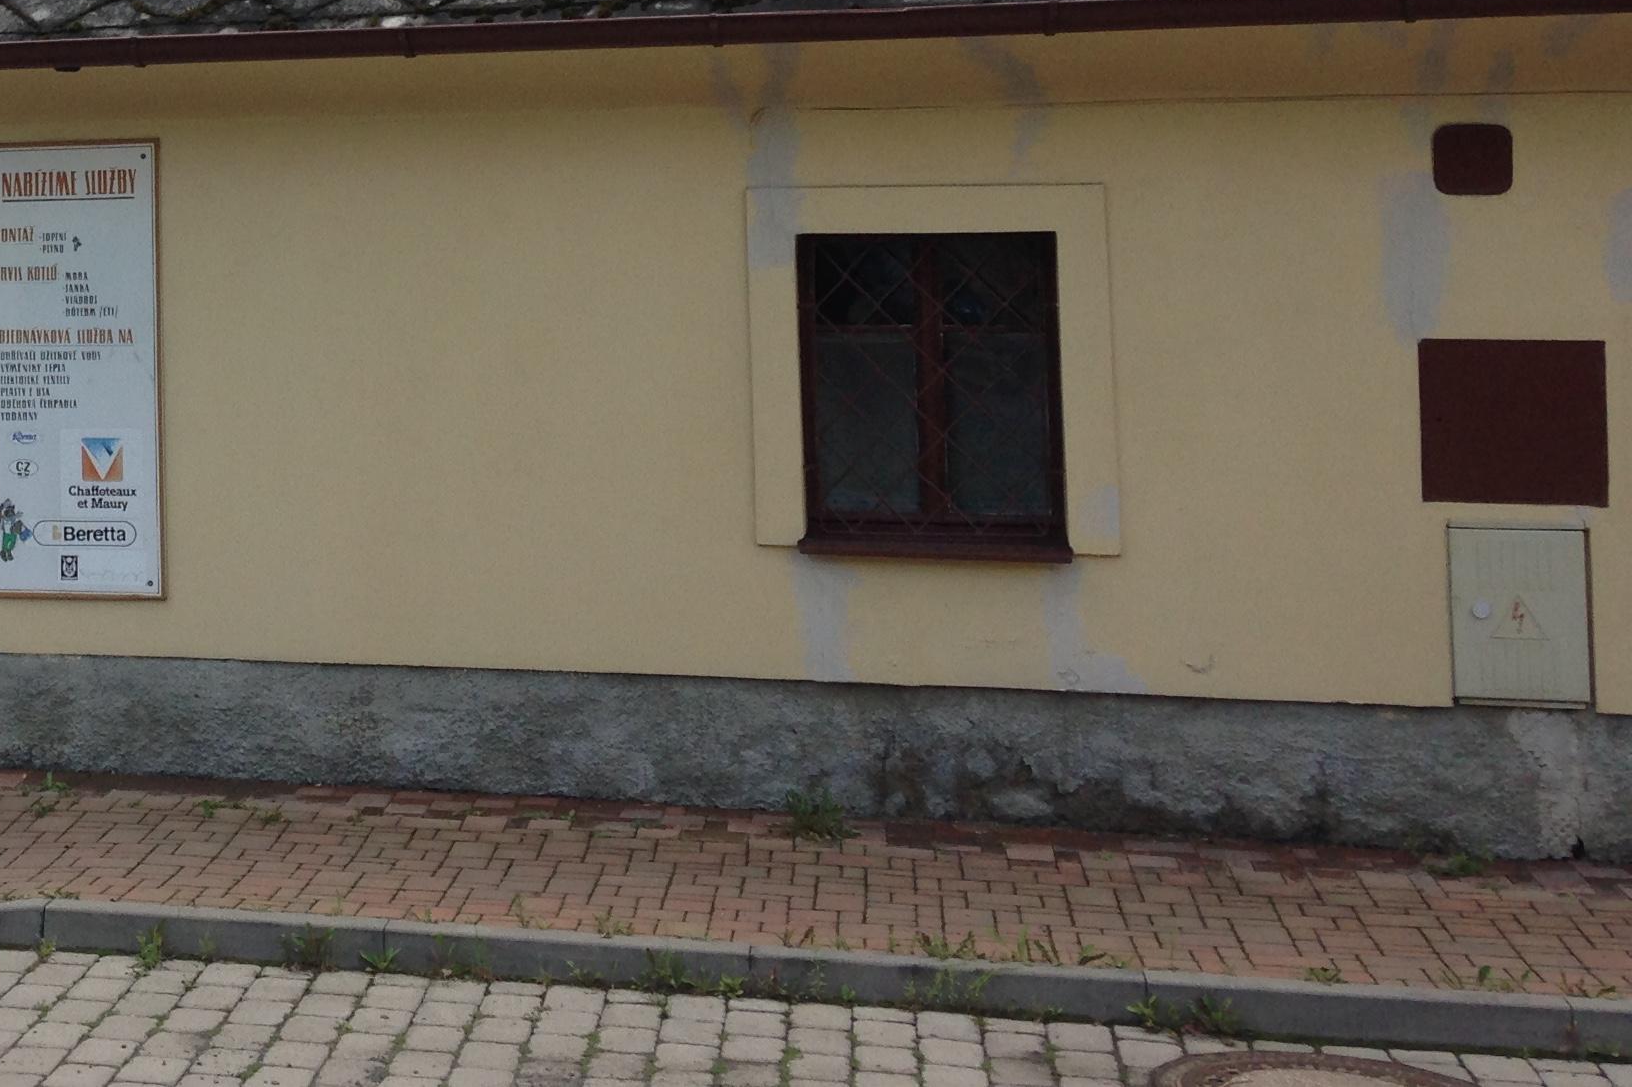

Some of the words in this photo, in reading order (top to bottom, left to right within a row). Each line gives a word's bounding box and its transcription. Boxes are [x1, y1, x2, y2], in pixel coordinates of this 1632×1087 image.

[2, 169, 77, 197] NABÍZÍME
[85, 166, 137, 195] SLUŽBY
[77, 327, 114, 344] SLUŽBA
[118, 329, 134, 344] NA
[16, 461, 30, 473] CZ
[68, 485, 137, 497] Chaffoteaux
[77, 499, 88, 508] et
[91, 498, 128, 512] Maury
[63, 526, 126, 541] Beretta
